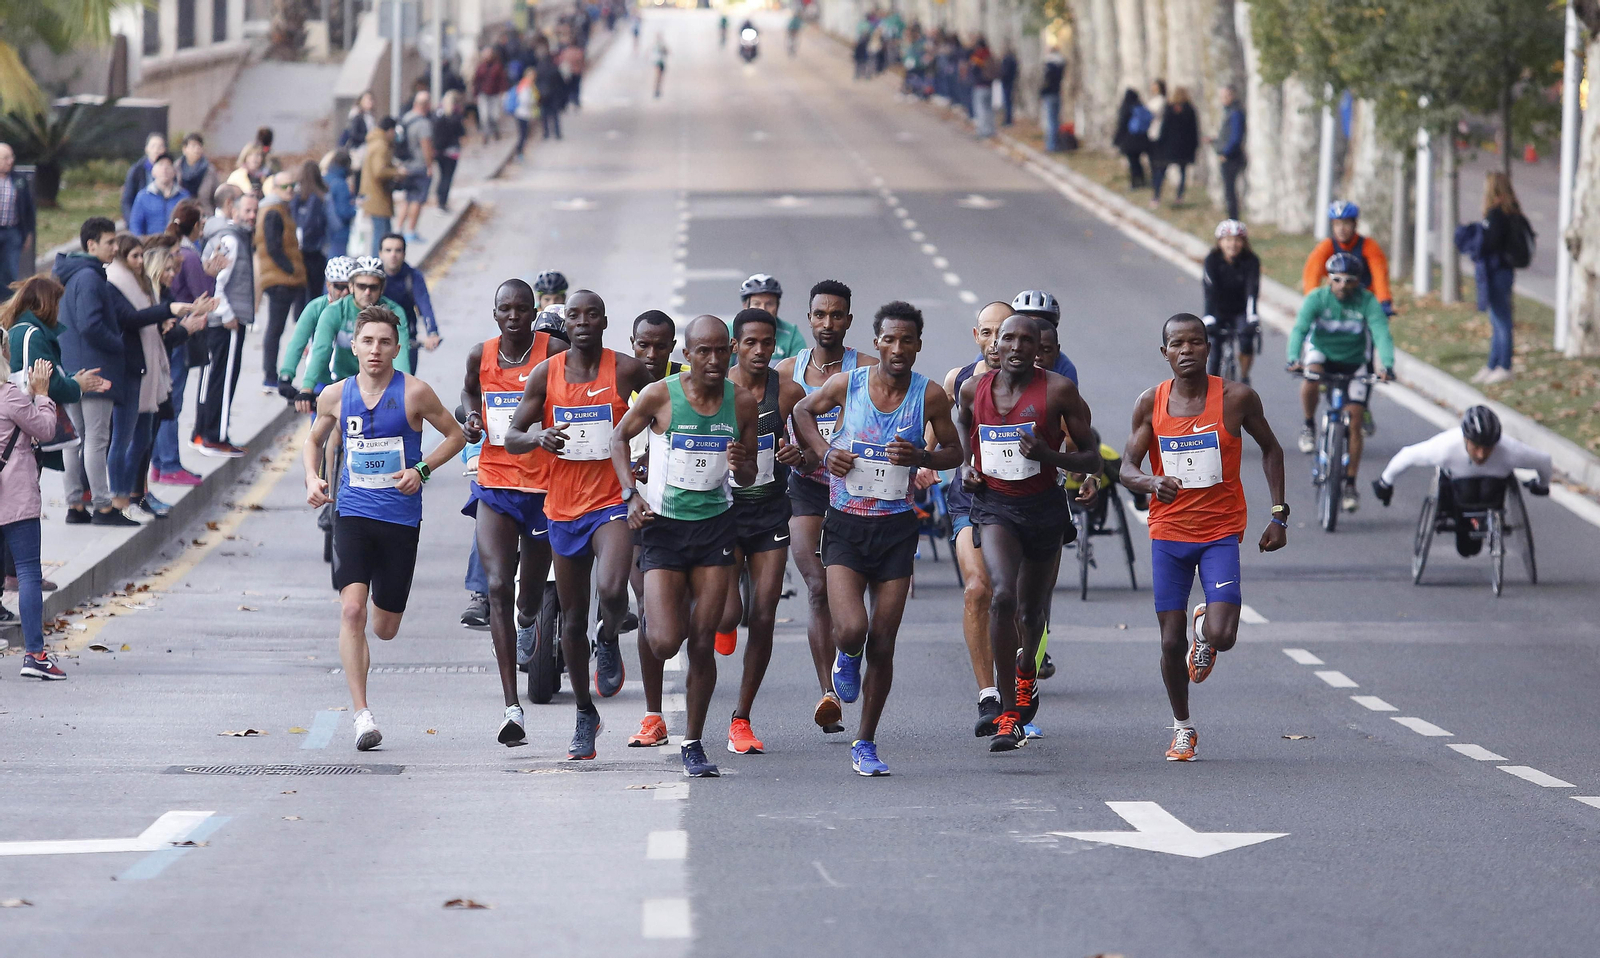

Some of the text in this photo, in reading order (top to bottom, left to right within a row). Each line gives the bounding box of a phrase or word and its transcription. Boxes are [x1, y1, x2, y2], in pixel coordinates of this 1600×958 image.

[580, 430, 586, 438] 2
[1002, 449, 1013, 458] 10
[365, 460, 385, 469] 3507
[695, 458, 707, 468] 28
[1187, 457, 1193, 466] 9
[875, 468, 886, 477] 11
